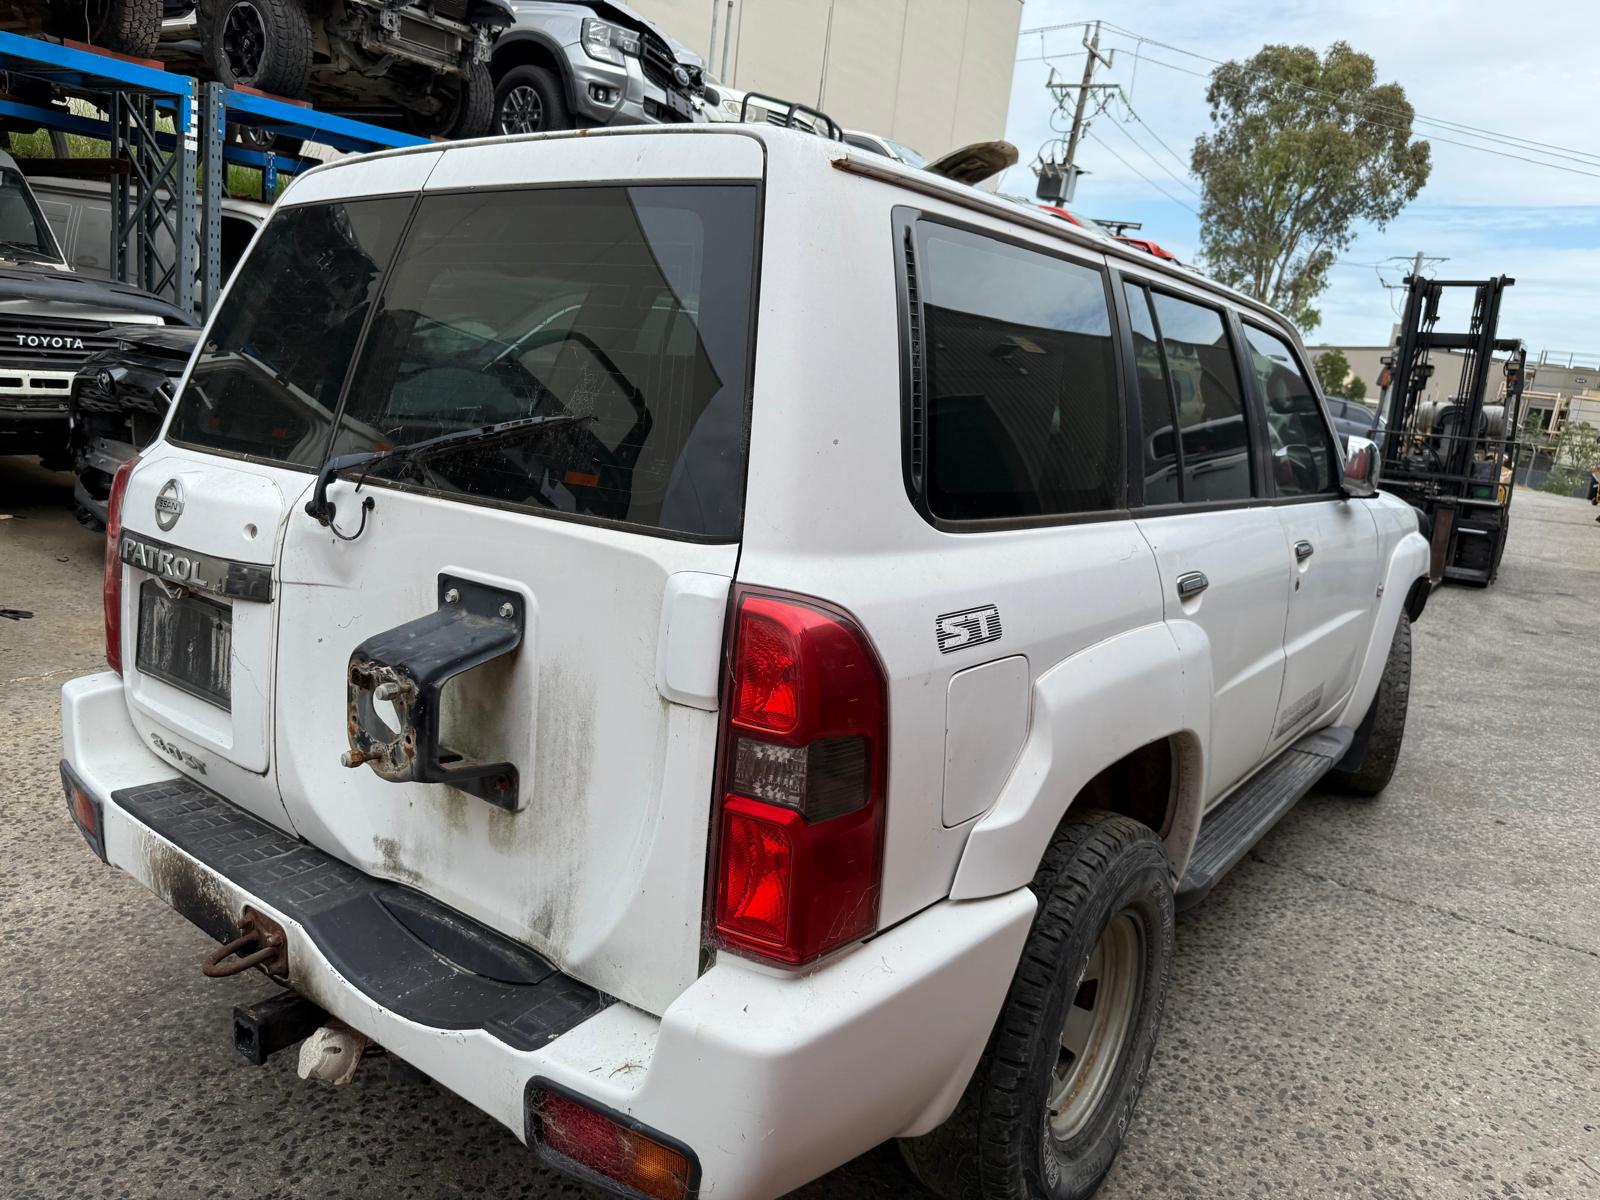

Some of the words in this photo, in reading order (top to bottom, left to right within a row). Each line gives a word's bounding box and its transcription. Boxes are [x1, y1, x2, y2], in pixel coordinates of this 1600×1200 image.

[16, 334, 84, 349] TOYOTA
[156, 497, 179, 512] SSAN
[121, 537, 208, 587] PATROL
[936, 604, 1001, 653] ST
